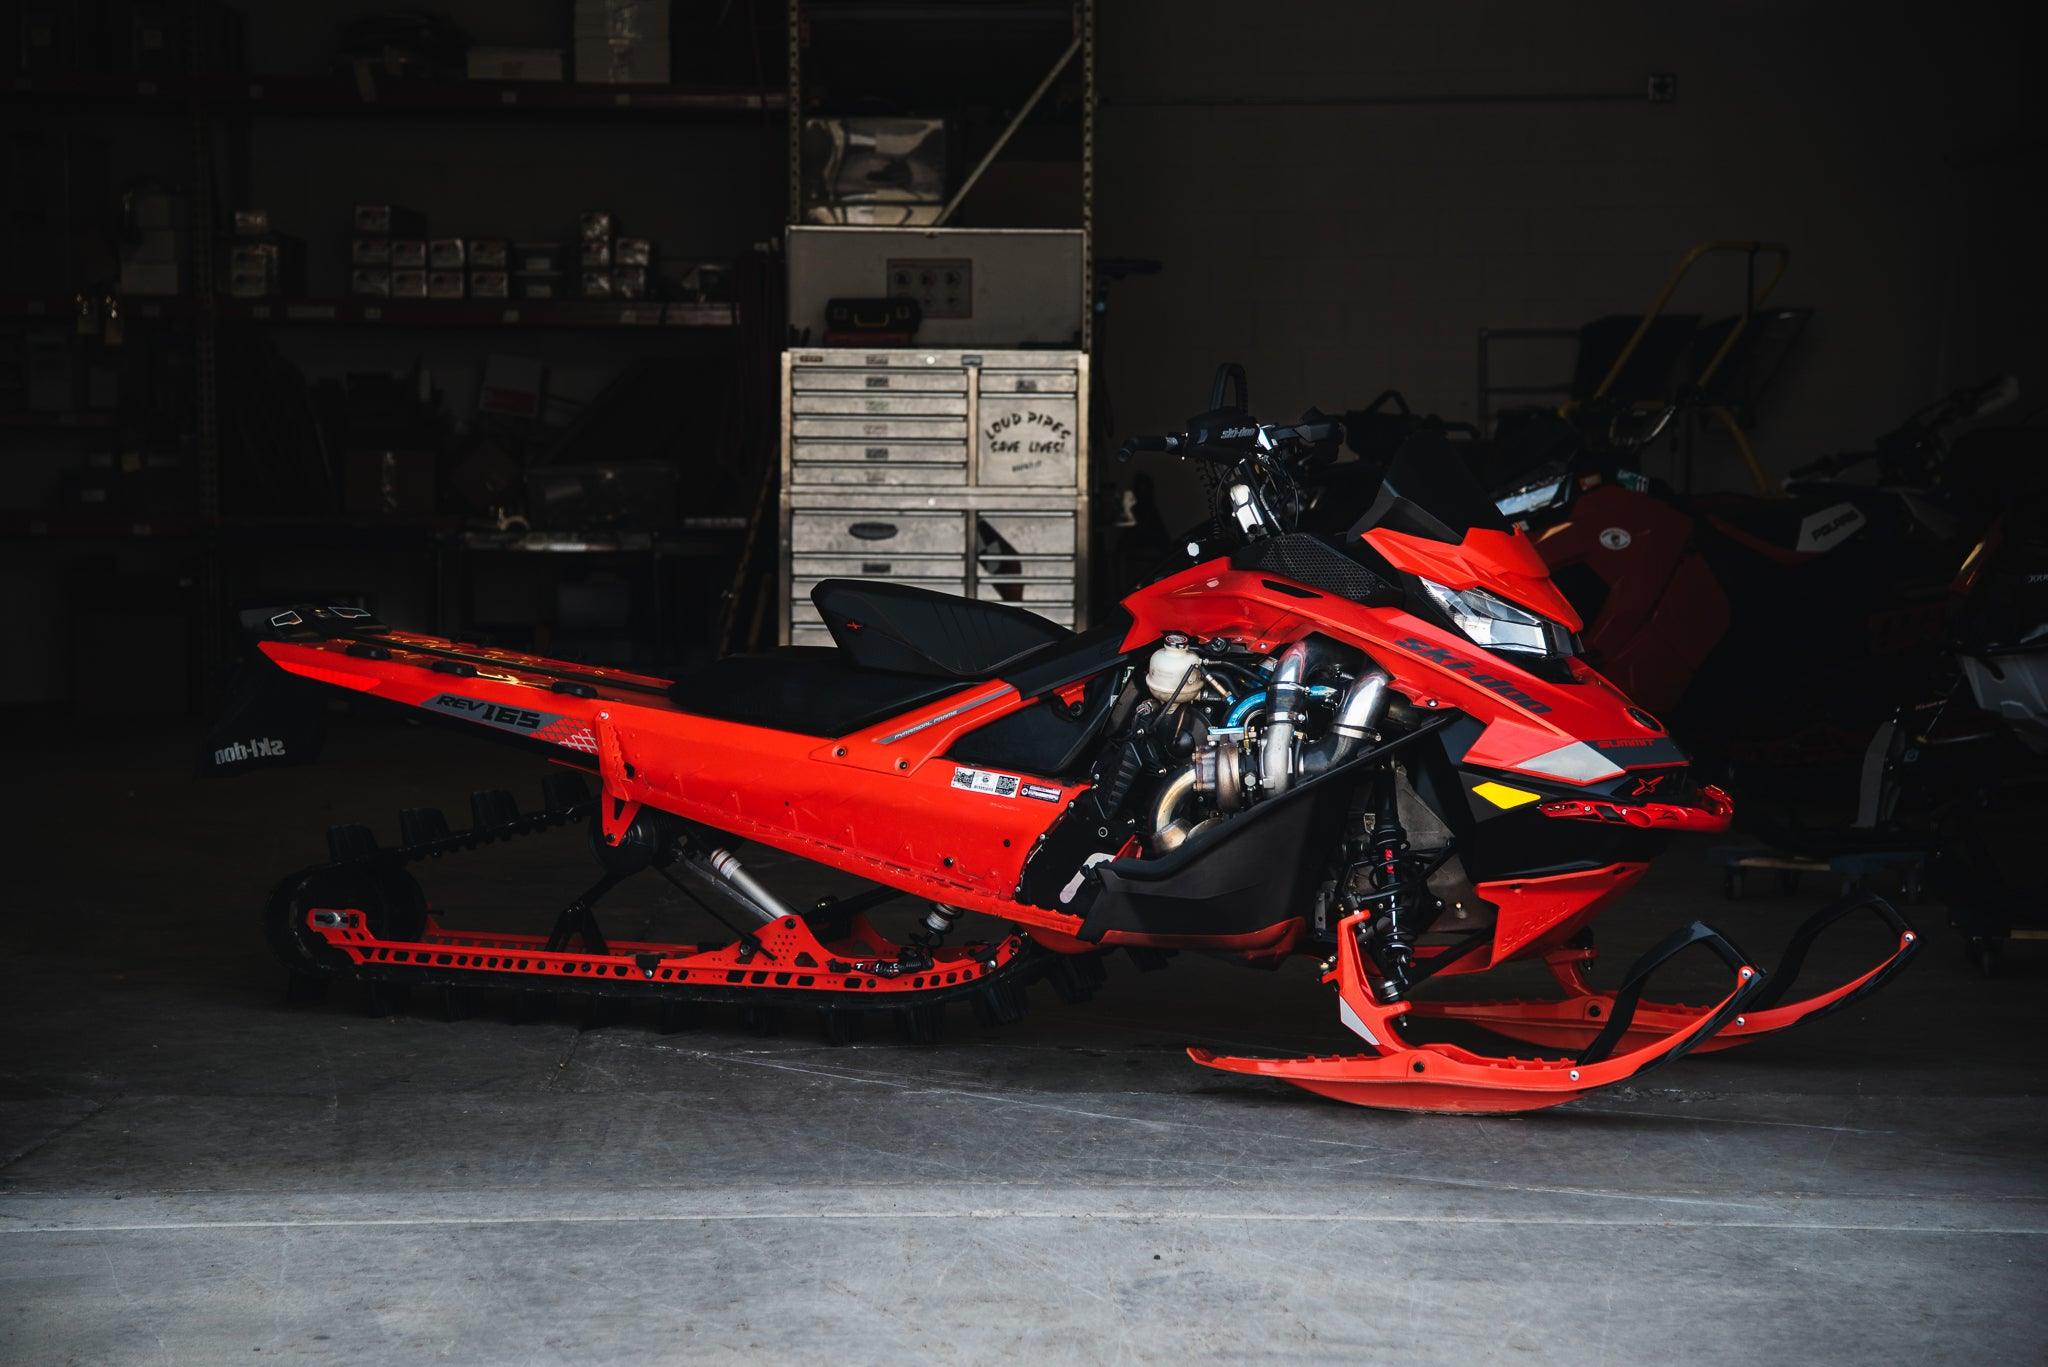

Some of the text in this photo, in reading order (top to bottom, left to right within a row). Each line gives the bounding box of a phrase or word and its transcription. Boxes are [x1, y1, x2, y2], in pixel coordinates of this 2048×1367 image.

[985, 411, 1071, 440] LOUD PIPES
[990, 440, 1065, 453] SAVE LIVES!
[1811, 510, 1859, 542] POLARIS
[437, 695, 541, 730] REV 165
